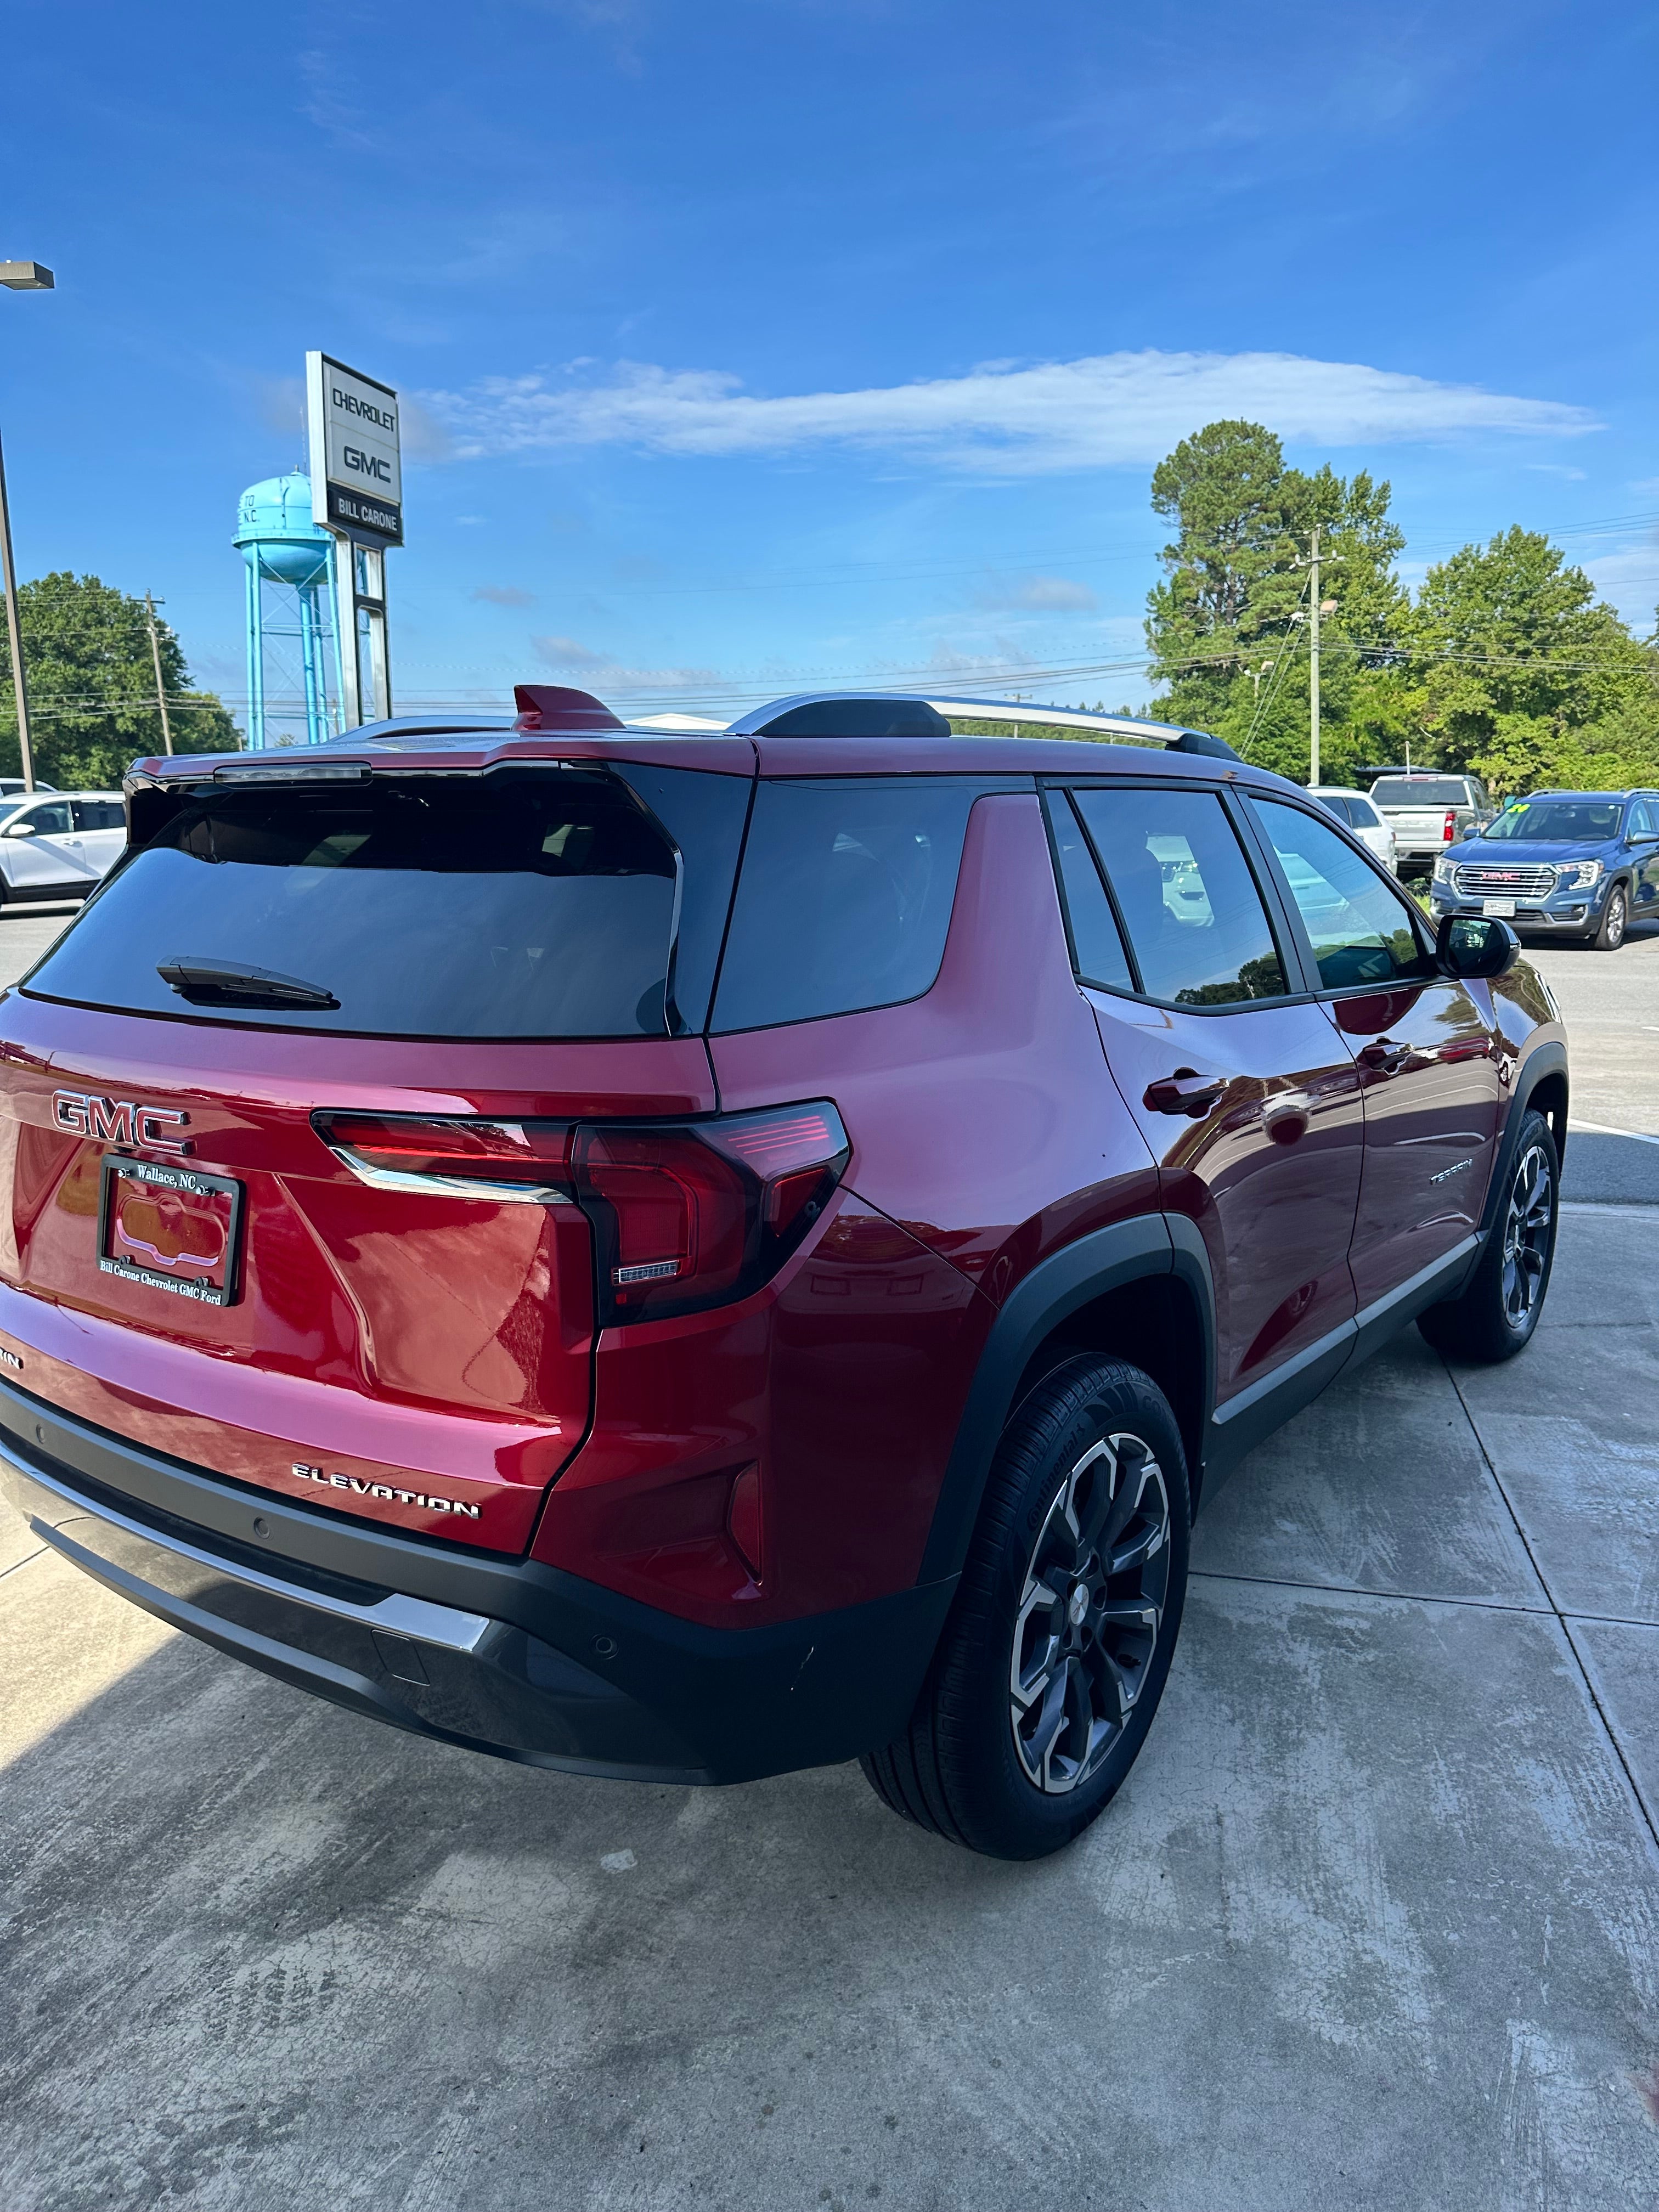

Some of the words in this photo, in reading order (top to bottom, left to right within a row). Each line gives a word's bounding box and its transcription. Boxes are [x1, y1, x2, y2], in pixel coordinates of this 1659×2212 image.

[333, 388, 396, 432] CHEVROLET
[344, 445, 391, 483] GMC
[338, 498, 359, 519] BILL
[361, 505, 397, 531] CARONE
[1481, 871, 1520, 881] GMC
[53, 1088, 195, 1155] GMC
[137, 1164, 177, 1188] Wallace,
[179, 1173, 196, 1189] NC
[100, 1260, 113, 1274] Bill
[114, 1265, 140, 1282] Carone
[140, 1272, 178, 1293] Chevrolet
[179, 1283, 200, 1299] GMC
[201, 1289, 222, 1306] Ford
[291, 1462, 483, 1519] ELEVATION
[1027, 1430, 1080, 1531] Continental
